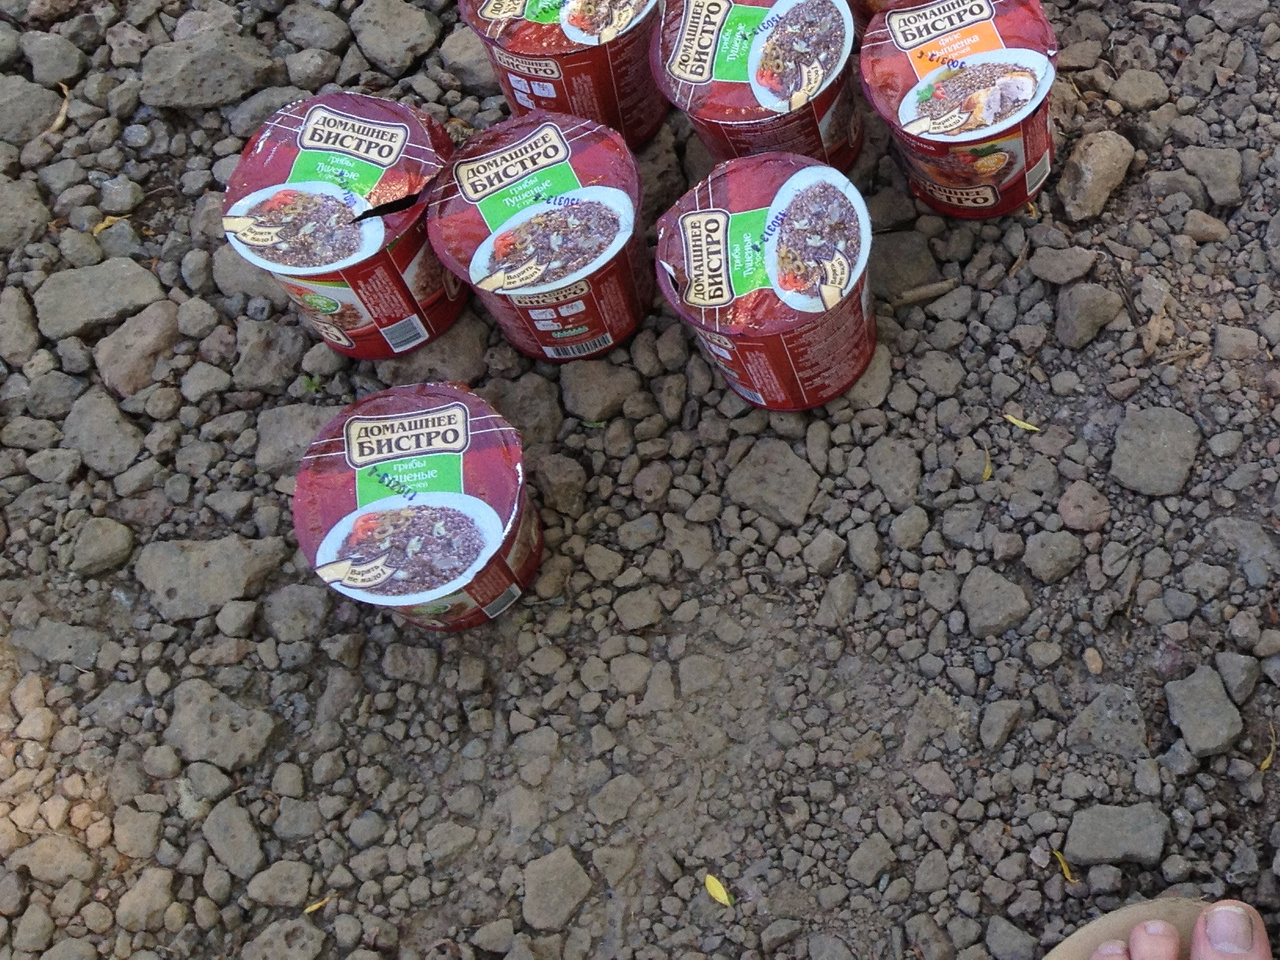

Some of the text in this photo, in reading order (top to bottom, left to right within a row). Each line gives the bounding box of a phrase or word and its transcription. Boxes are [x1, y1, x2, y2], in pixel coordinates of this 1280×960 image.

[678, 0, 706, 74] ДОМАШНЕЕ
[901, 3, 985, 43] БИСТРО
[938, 30, 962, 47] филе
[690, 1, 722, 77] БИСТРО
[309, 128, 395, 159] БИСТРО
[315, 115, 399, 144] ДОМАШНЕЕ
[466, 133, 552, 181] ДОМАШНЕЕ
[468, 143, 560, 195] БИСТРО
[502, 178, 552, 208] Тушеные
[508, 176, 539, 195] грибы
[690, 220, 706, 300] ДОМАШНЕЕ
[704, 218, 724, 300] БИСТРО
[733, 243, 741, 270] грибы
[742, 232, 752, 278] Тушеные
[356, 413, 459, 441] ДОМАШНЕЕ
[357, 428, 460, 458] БИСТРО
[393, 459, 427, 472] грибы
